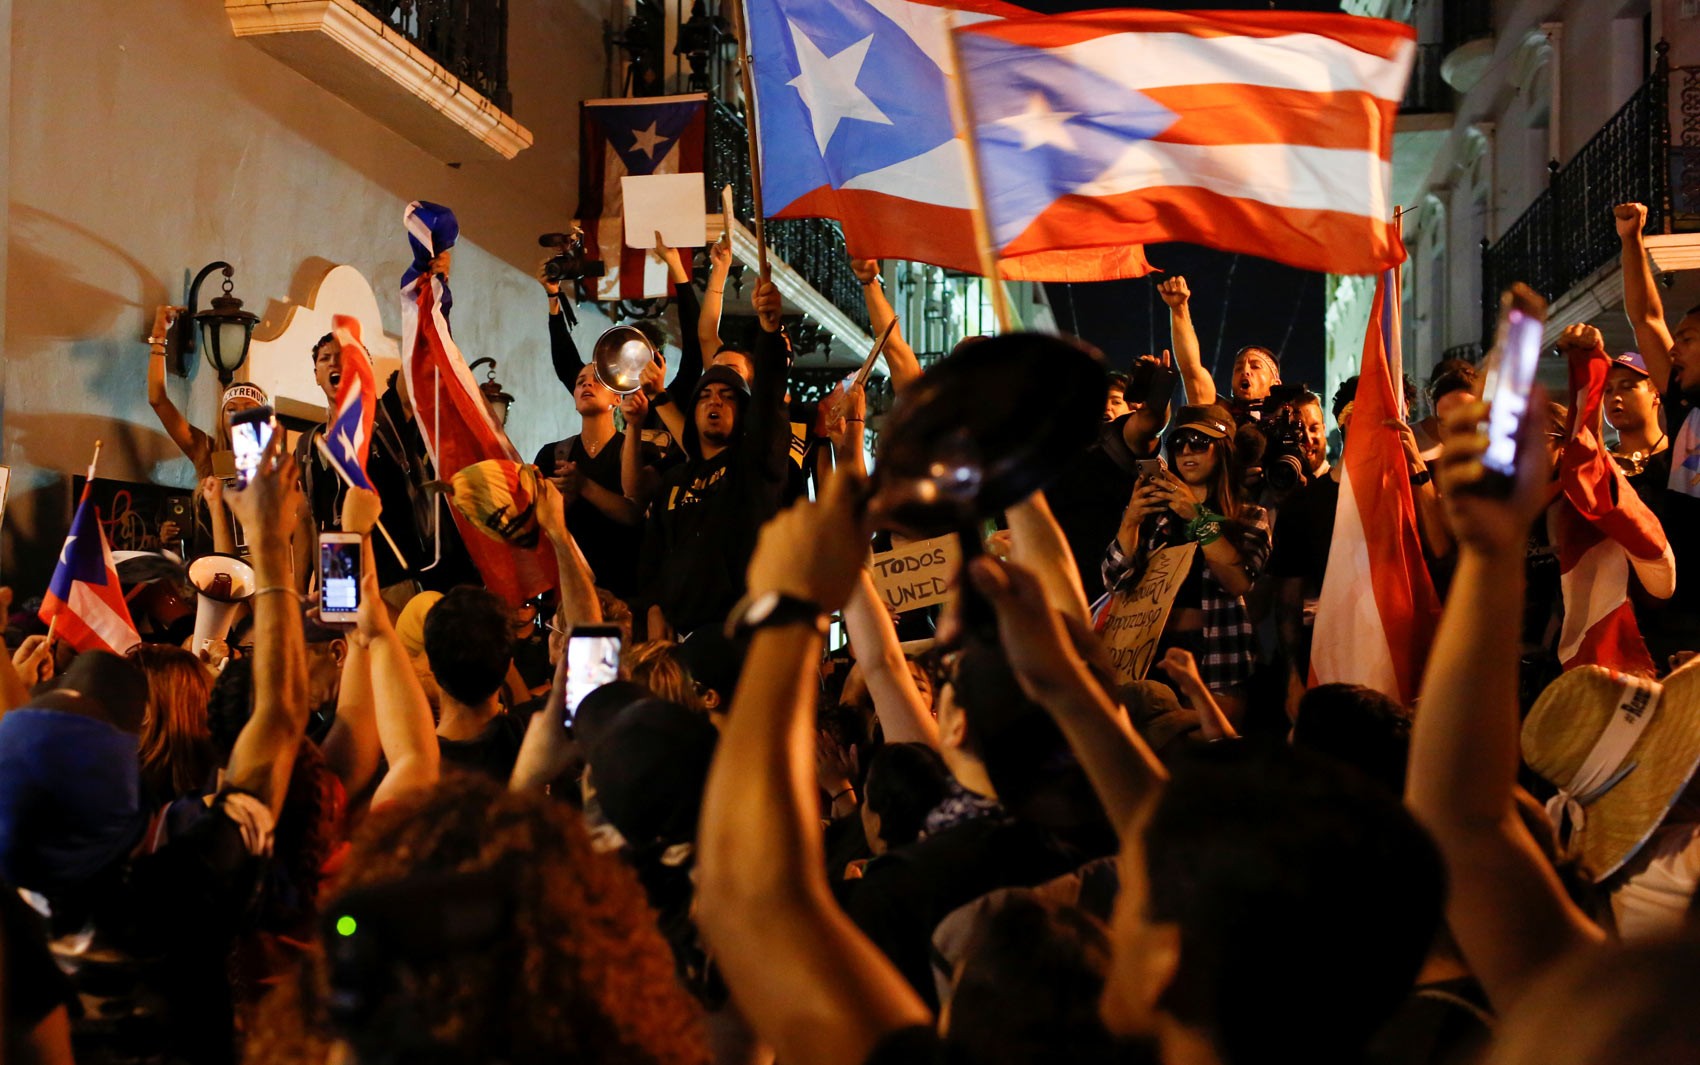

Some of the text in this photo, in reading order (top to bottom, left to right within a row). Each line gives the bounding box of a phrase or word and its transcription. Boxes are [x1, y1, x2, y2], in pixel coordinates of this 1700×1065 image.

[874, 548, 946, 578] TODOS
[886, 577, 948, 607] UNID
[1109, 638, 1155, 681] Dicta
